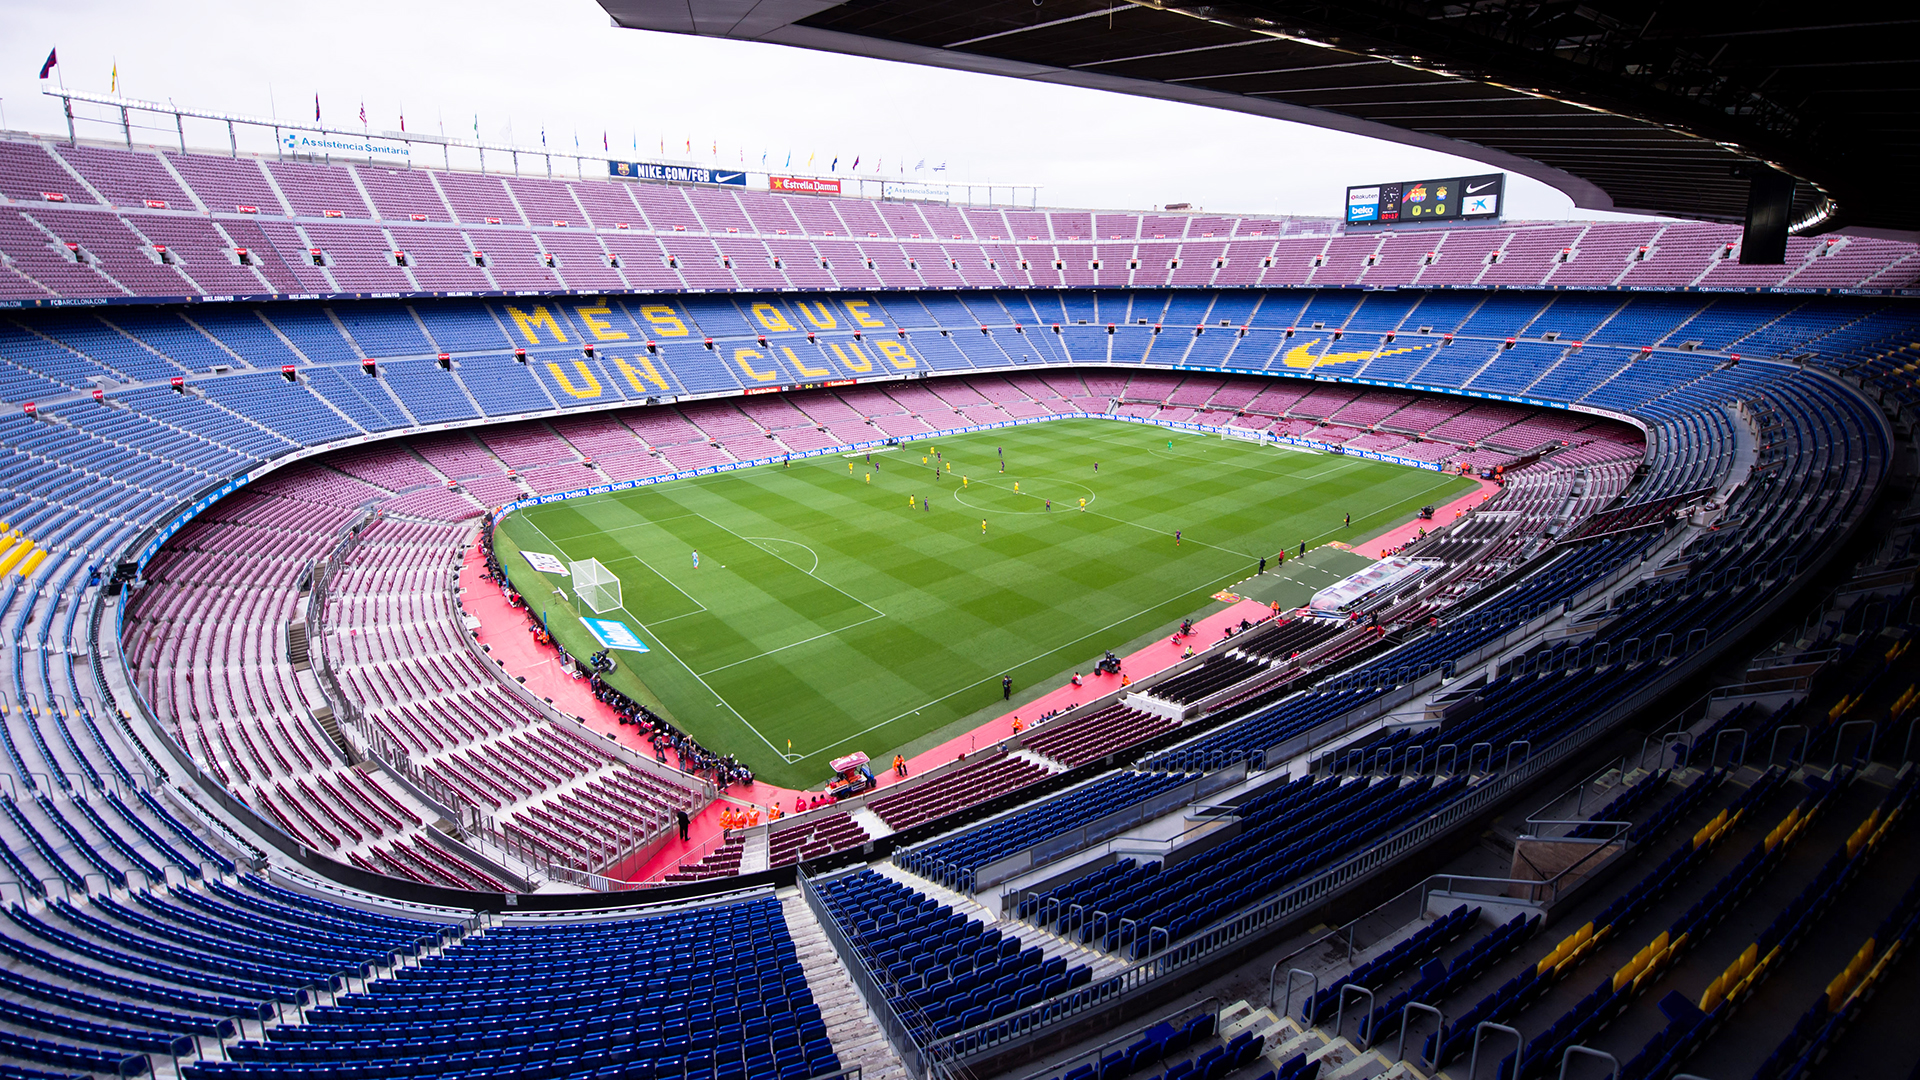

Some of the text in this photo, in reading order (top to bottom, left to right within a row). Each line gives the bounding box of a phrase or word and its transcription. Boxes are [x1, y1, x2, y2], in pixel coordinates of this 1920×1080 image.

[302, 138, 409, 155] Assistència Sanitària
[637, 165, 710, 182] NIKE.COM/FCB
[783, 179, 838, 191] Estrella Damm
[1352, 206, 1373, 215] beko
[1412, 205, 1422, 216] 0
[1435, 204, 1445, 215] 0
[507, 297, 884, 344] MÉS QUE
[547, 340, 916, 399] UN CLUB
[1345, 447, 1360, 456] beko
[1363, 451, 1379, 460] beko
[1381, 454, 1398, 463] beko
[1400, 458, 1418, 467] beko
[717, 464, 734, 472] beko
[736, 462, 752, 470] beko
[1420, 462, 1438, 471] beko
[677, 470, 695, 479] beko
[697, 467, 715, 476] beko
[236, 478, 246, 487] beko
[634, 478, 655, 487] beko
[656, 474, 675, 482] beko
[222, 485, 232, 495] beko
[589, 485, 610, 494] beko
[612, 482, 632, 490] beko
[541, 494, 564, 503] beko
[565, 489, 587, 499] beko
[209, 494, 218, 504] beko
[517, 498, 538, 509] beko
[196, 502, 205, 512] beko
[183, 511, 192, 522] beko
